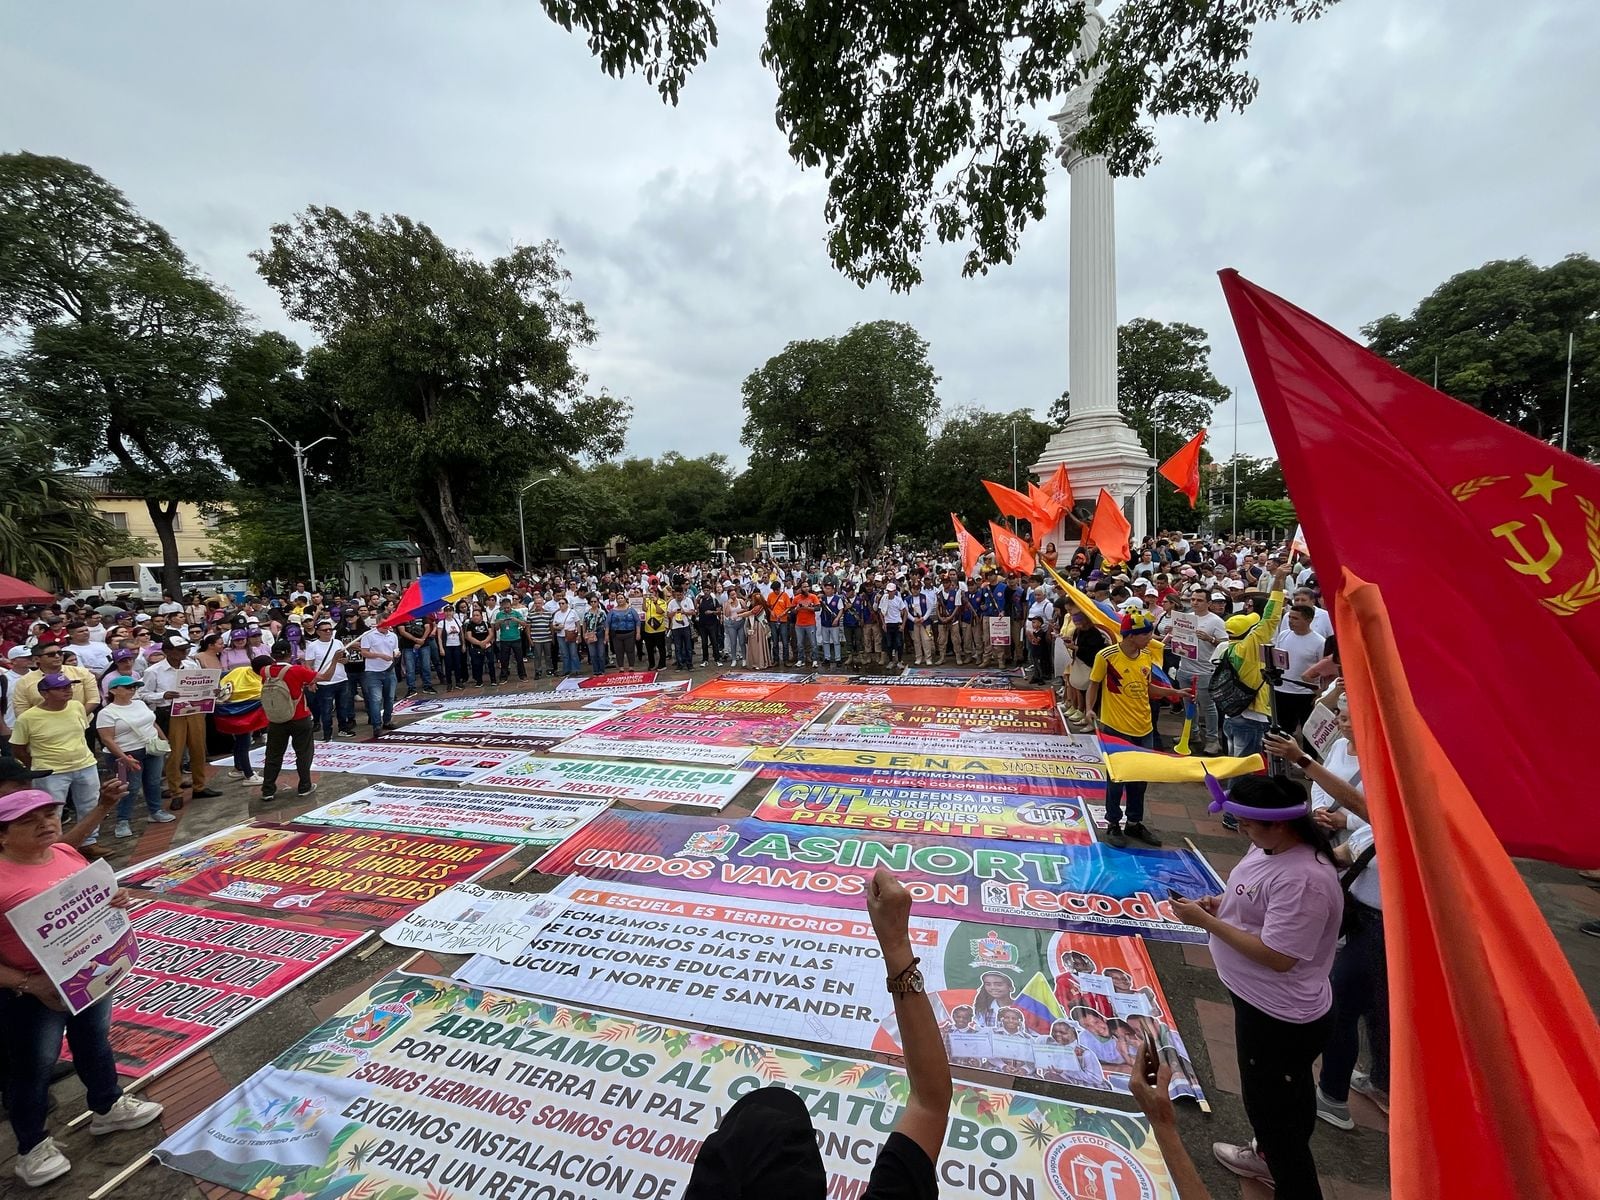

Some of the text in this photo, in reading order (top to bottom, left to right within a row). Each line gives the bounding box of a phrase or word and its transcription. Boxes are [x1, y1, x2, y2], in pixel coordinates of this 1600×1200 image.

[646, 717, 709, 727] PODER
[941, 707, 994, 715] SALUD
[455, 736, 554, 746] SANTANDER
[600, 725, 633, 733] DEL
[550, 761, 737, 786] SINTRAELECOL
[560, 772, 647, 787] SUBDIRECTIVA
[877, 778, 927, 788] PUEBLO
[929, 781, 1019, 793] COLOMBIANO
[893, 770, 977, 781] PATRIMONIO
[480, 776, 726, 805] PRESENTE PRESENTE PRESENTE
[776, 783, 1005, 815] CUT EN DEFENSA DE
[867, 797, 1005, 815] LAS REFORMAS
[887, 809, 980, 825] SOCIALES
[276, 847, 459, 880] POR AHORA ES
[343, 835, 376, 850] NO
[368, 838, 405, 851] ES
[396, 841, 484, 863] LUCHAR
[738, 832, 1070, 885] ASINORT
[220, 859, 448, 901] LUCHAR POR USTEDES
[449, 883, 485, 899] FALSO
[575, 848, 968, 906] UNIDOS VAMOS ON
[36, 887, 111, 940] Popular
[44, 884, 99, 921] Consulta
[578, 891, 929, 943] LA ESCUELA ES TERRITORIO DE AZ
[397, 926, 434, 943] PARA
[560, 909, 886, 961] ECHAZAMOS LOS ACTOS VIOLENTO
[1026, 911, 1072, 921] COLOMBIANA
[1082, 916, 1140, 928] TRABAJADORES
[91, 934, 104, 945] QR
[165, 914, 346, 962] NORTE INCLUYENTE
[563, 924, 835, 972] LOS ÚLTIMOS DÍAS EN LAS
[184, 952, 286, 989] APOYA
[674, 960, 820, 990] EDUCATIVAS
[822, 979, 856, 997] EN
[502, 952, 881, 1025] ÚCUTA Y NORTE DE SANTANDER.
[423, 1012, 713, 1095] ABRAZAMOS AL
[390, 1037, 442, 1065] POR
[445, 1048, 503, 1077] UNA
[504, 1061, 597, 1102] TIERRA
[600, 1083, 642, 1109] EN
[645, 1093, 706, 1126] PAZ
[347, 1060, 613, 1142] ¡SOMOS HERMANOS, SOMOS
[340, 1096, 677, 1200] EXIGIMOS INSTALACIÓN DE
[366, 1138, 487, 1193] PARA UN
